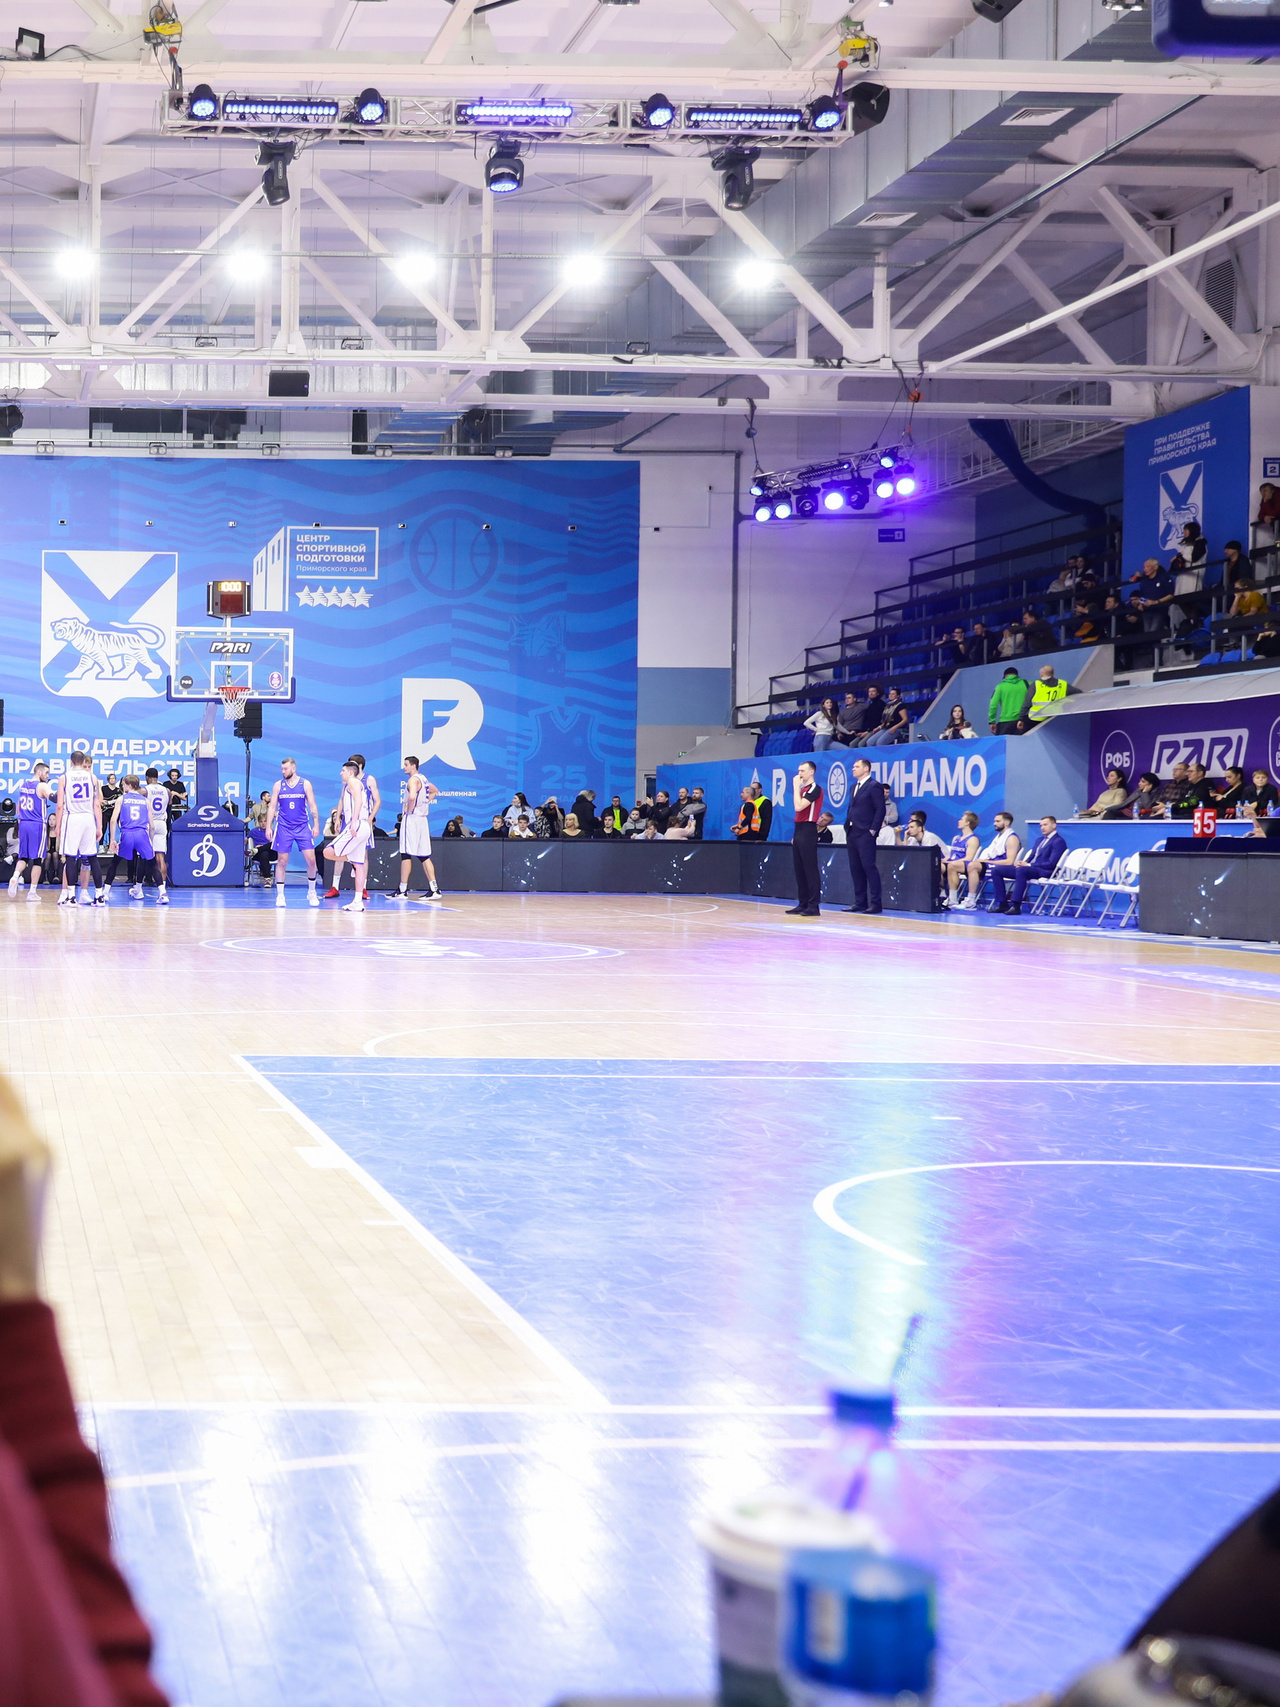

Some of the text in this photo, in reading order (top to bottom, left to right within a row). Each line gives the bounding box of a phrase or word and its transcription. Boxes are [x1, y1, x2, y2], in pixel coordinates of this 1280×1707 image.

[1154, 421, 1211, 447] ПРИ ПОДДЕРЖКЕ
[1153, 431, 1211, 456] ПРАВИТЕЛЬСТВА
[1148, 438, 1217, 466] ПРИМОРСКОГО КРАЯ
[296, 534, 330, 543] ЦЕНТР
[296, 543, 367, 553] СПОРТИВНОЙ
[296, 554, 365, 563] ПОДГОТОВКИ
[296, 564, 348, 572] Приморского
[210, 642, 251, 653] PARI
[1047, 690, 1058, 702] 10
[0, 737, 217, 757] ПРИ ПОДДЕРЖК
[1105, 752, 1131, 768] РФБ
[541, 764, 588, 790] 25
[72, 783, 89, 799] 21
[20, 796, 34, 811] 28
[152, 797, 163, 812] 6
[289, 801, 295, 809] 6
[130, 805, 140, 820] 5
